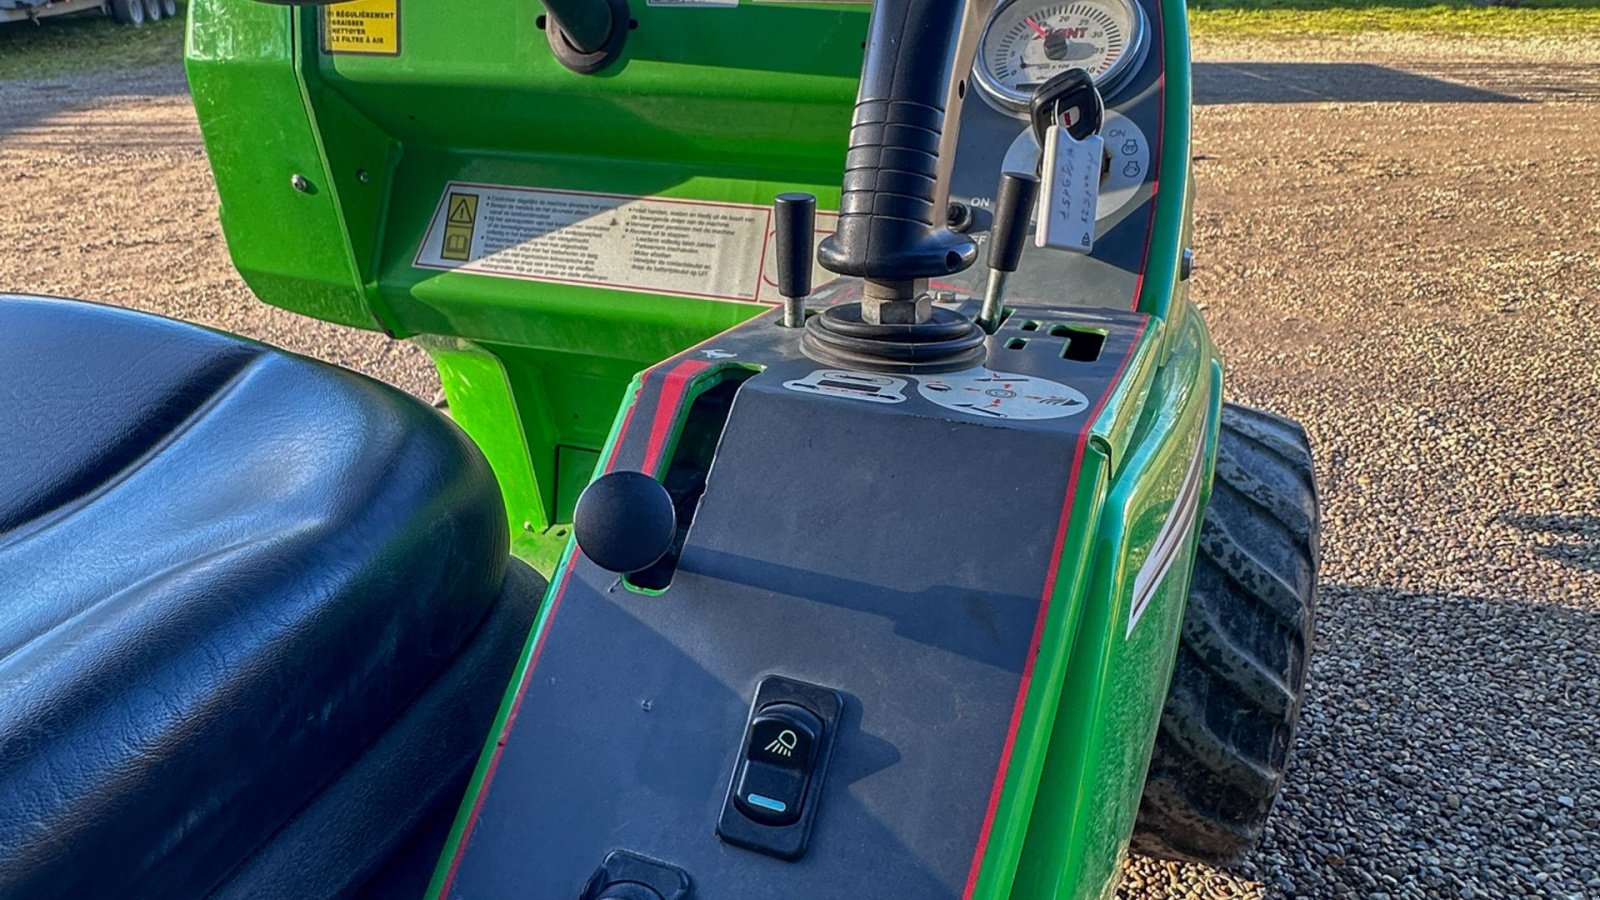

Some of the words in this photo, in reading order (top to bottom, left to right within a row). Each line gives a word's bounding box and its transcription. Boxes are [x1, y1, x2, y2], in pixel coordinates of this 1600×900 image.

[1059, 15, 1070, 23] 20
[1091, 31, 1104, 39] 30
[1109, 129, 1126, 138] ON
[970, 197, 990, 207] ON
